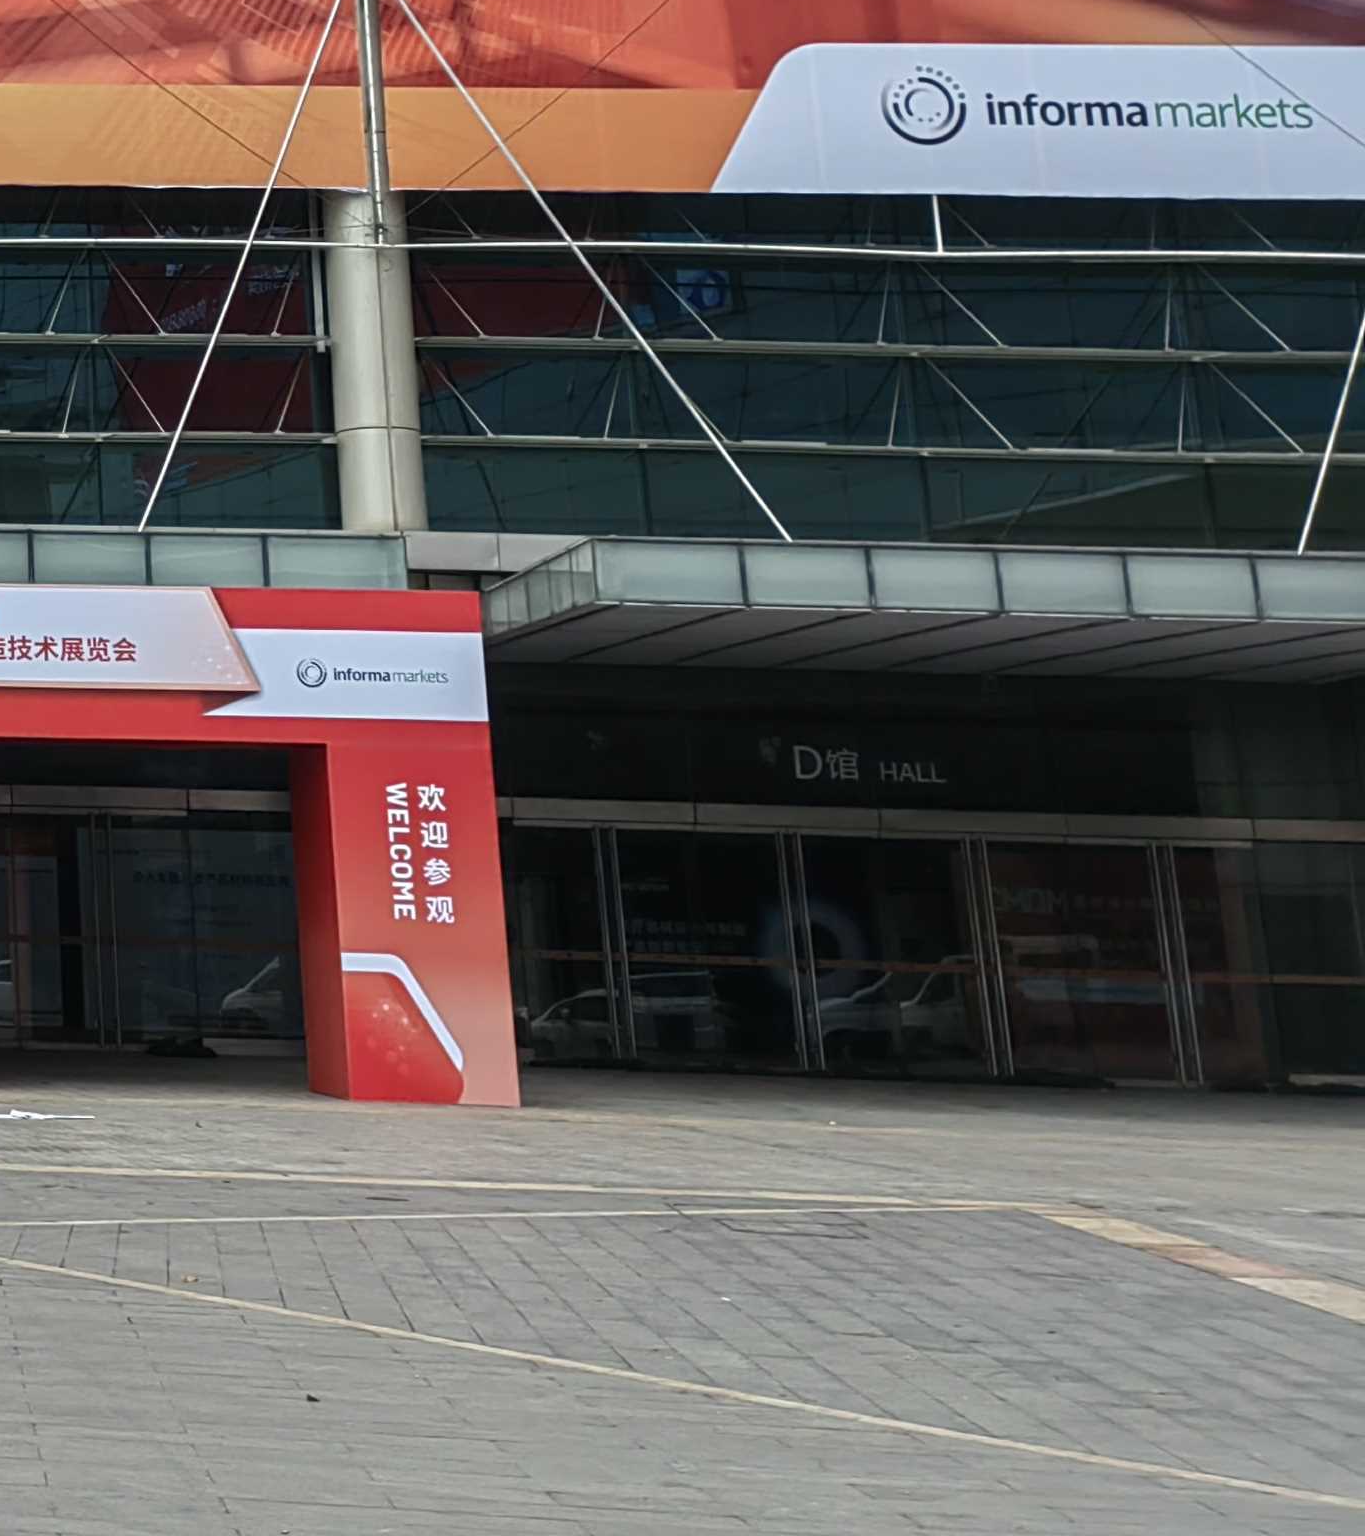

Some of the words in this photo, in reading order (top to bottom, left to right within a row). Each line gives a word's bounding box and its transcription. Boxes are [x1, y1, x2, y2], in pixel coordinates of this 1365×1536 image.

[793, 744, 860, 782] D馆
[879, 761, 947, 784] HALL
[386, 782, 416, 920] WELCOME
[417, 783, 455, 923] 欢迎参观
